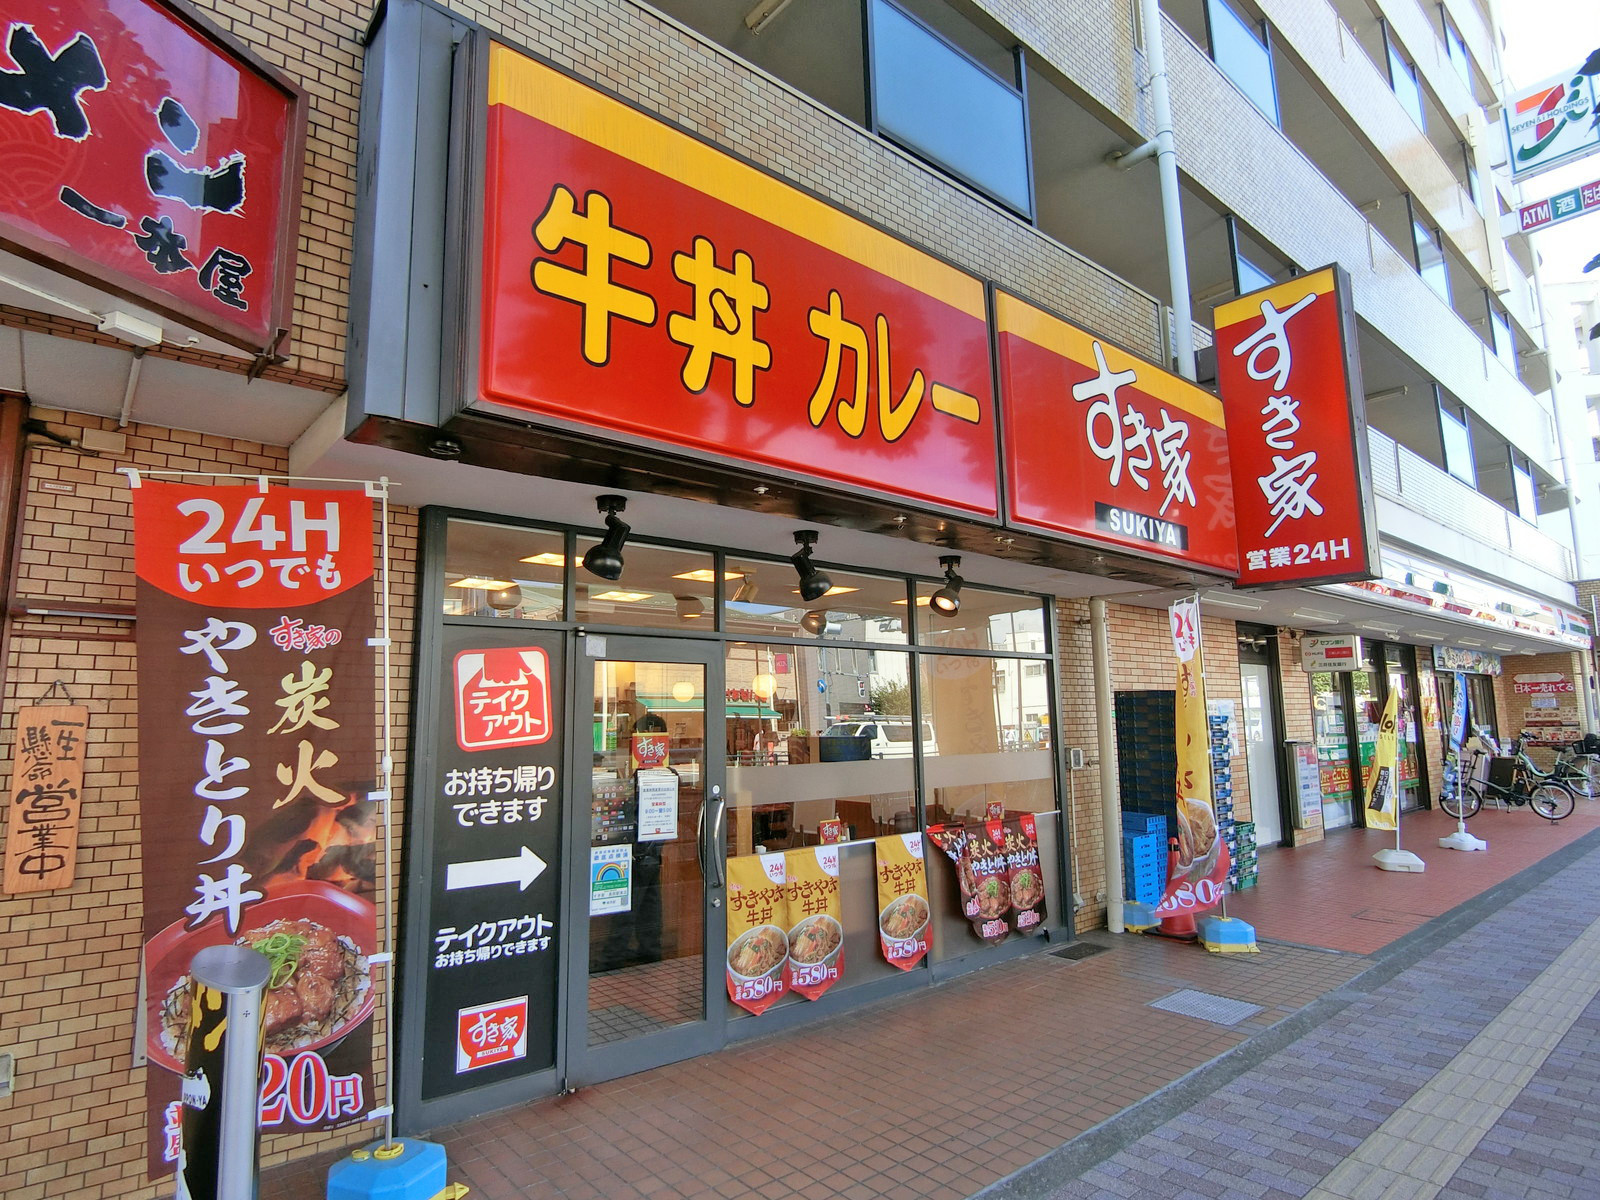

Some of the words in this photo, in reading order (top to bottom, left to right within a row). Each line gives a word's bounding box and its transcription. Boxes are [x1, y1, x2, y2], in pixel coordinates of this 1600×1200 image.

[1511, 119, 1537, 135] SEVEN
[1546, 96, 1590, 119] HOLDINGS
[1521, 203, 1550, 230] ATM
[1556, 193, 1575, 215] 酒
[531, 183, 773, 407] 牛丼
[808, 288, 982, 443] カレー
[1072, 340, 1196, 517] すき家
[1232, 293, 1325, 538] すき家
[176, 496, 340, 554] 24H
[1109, 508, 1177, 546] SUKIYA
[1246, 537, 1351, 571] 営業24H
[177, 553, 342, 592] いつでも
[269, 615, 342, 654] すき家の
[469, 688, 530, 714] テイク
[51, 719, 84, 760] 一生
[266, 660, 346, 810] 炭火
[482, 711, 542, 737] アウト
[637, 737, 665, 760] すき家
[179, 616, 263, 935] やきとり丼
[443, 765, 555, 797] お持ち帰り
[452, 795, 548, 827] できます
[15, 778, 78, 880] 営業中
[1004, 833, 1026, 852] 炭火
[969, 839, 993, 859] 炭火
[879, 859, 923, 884] すきやき
[893, 877, 916, 896] 牛丼
[729, 885, 785, 911] すきやき
[787, 876, 838, 902] すきやき
[746, 905, 773, 926] 牛丼
[801, 896, 828, 915] 牛丼
[434, 913, 554, 952] テイクアウト
[434, 936, 552, 968] お持ち帰りできます
[468, 1012, 519, 1048] すき家
